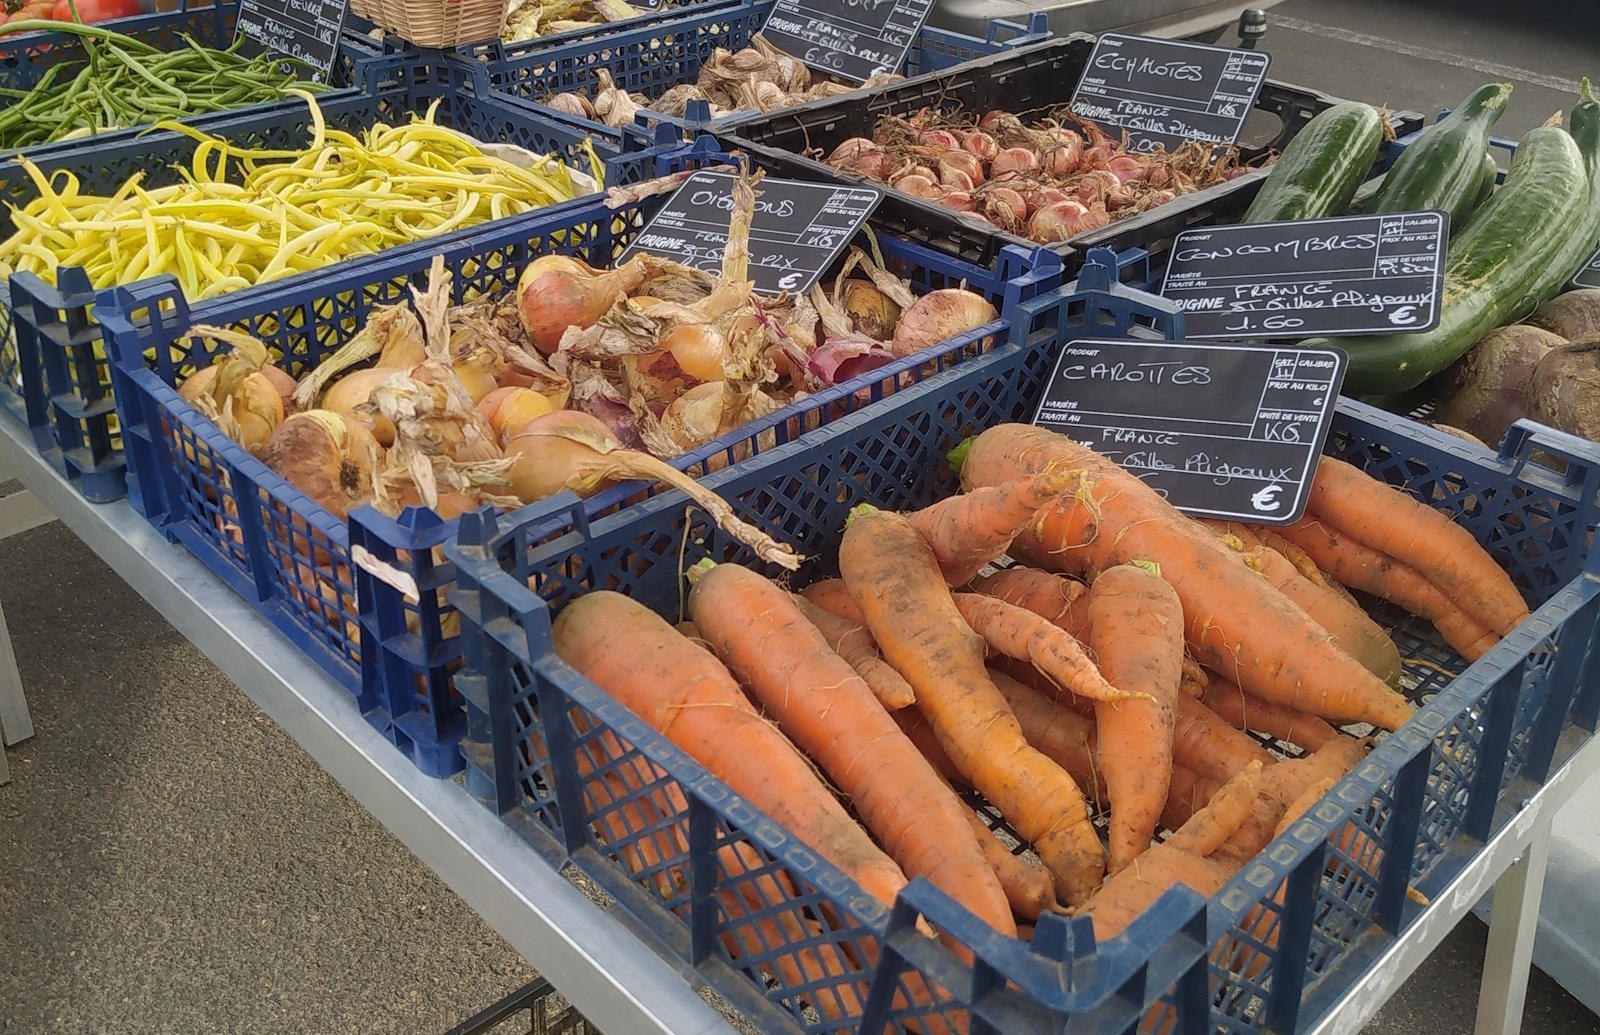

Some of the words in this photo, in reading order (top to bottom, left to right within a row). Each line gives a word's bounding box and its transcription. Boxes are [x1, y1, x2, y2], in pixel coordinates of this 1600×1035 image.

[769, 16, 803, 34] ORIGINE
[807, 20, 858, 42] FRANCE
[804, 47, 844, 68] 6.50
[1071, 102, 1113, 119] ORIGINE
[1117, 101, 1170, 117] FRANCE
[1128, 116, 1166, 133] Gilles
[639, 234, 686, 250] ORIGINE
[1179, 234, 1213, 242] PRODUIT
[779, 272, 804, 290] €
[1169, 271, 1202, 279] VARIÉTÉ
[1167, 280, 1194, 288] TRAITÉ
[1235, 282, 1333, 299] FRANCE
[1266, 297, 1325, 311] Gilles
[1388, 305, 1418, 325] €
[1065, 348, 1101, 357] PRODUIT
[1298, 359, 1335, 369] CALIBRE
[1063, 361, 1212, 385] CAROTTES
[1268, 381, 1291, 390] PRIX
[1290, 382, 1305, 391] AU
[1305, 383, 1328, 392] KILO
[1045, 400, 1079, 409] VARIÉTÉ
[1313, 397, 1324, 406] €
[1041, 412, 1068, 421] TRAITÉ
[1067, 414, 1081, 423] AU
[1259, 411, 1281, 420] UNITÉ
[1281, 413, 1294, 421] DE
[1293, 415, 1320, 423] VENTE
[1102, 428, 1180, 445] FRANCE
[1250, 484, 1284, 512] €
